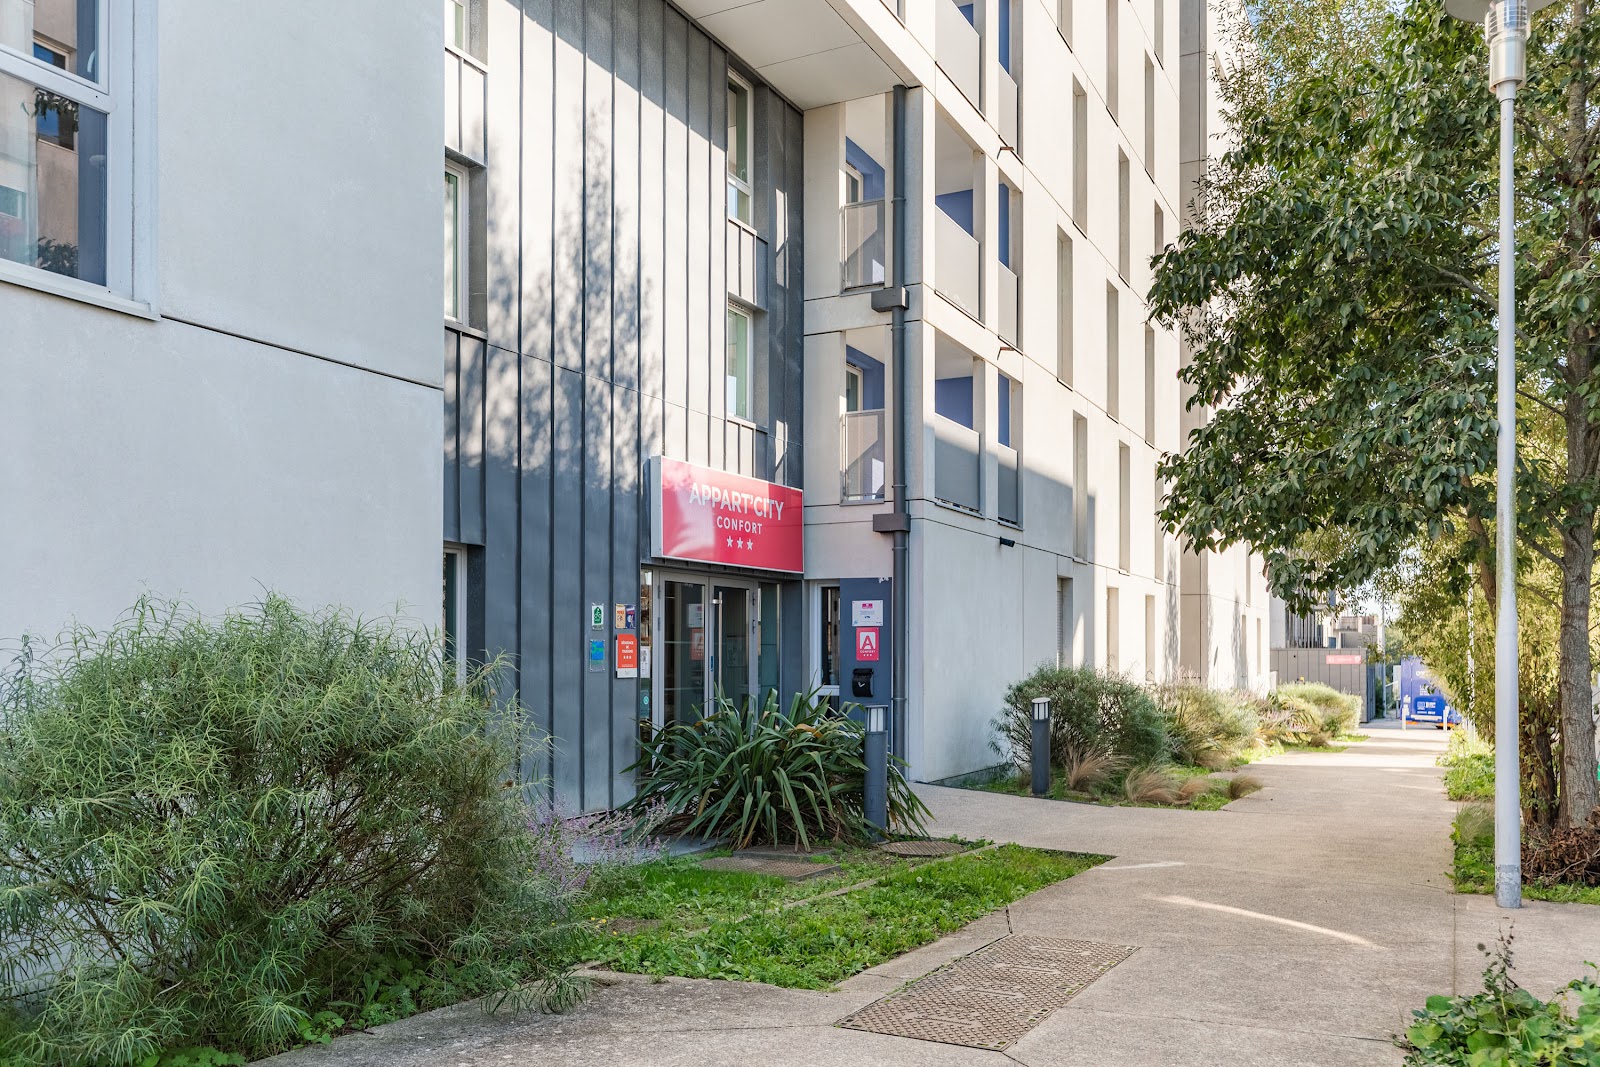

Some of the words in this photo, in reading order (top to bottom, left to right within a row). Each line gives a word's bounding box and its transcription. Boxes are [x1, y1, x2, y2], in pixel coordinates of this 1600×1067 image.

[689, 483, 785, 521] APPART'CITY
[716, 515, 763, 535] CONFORT
[862, 635, 874, 650] A
